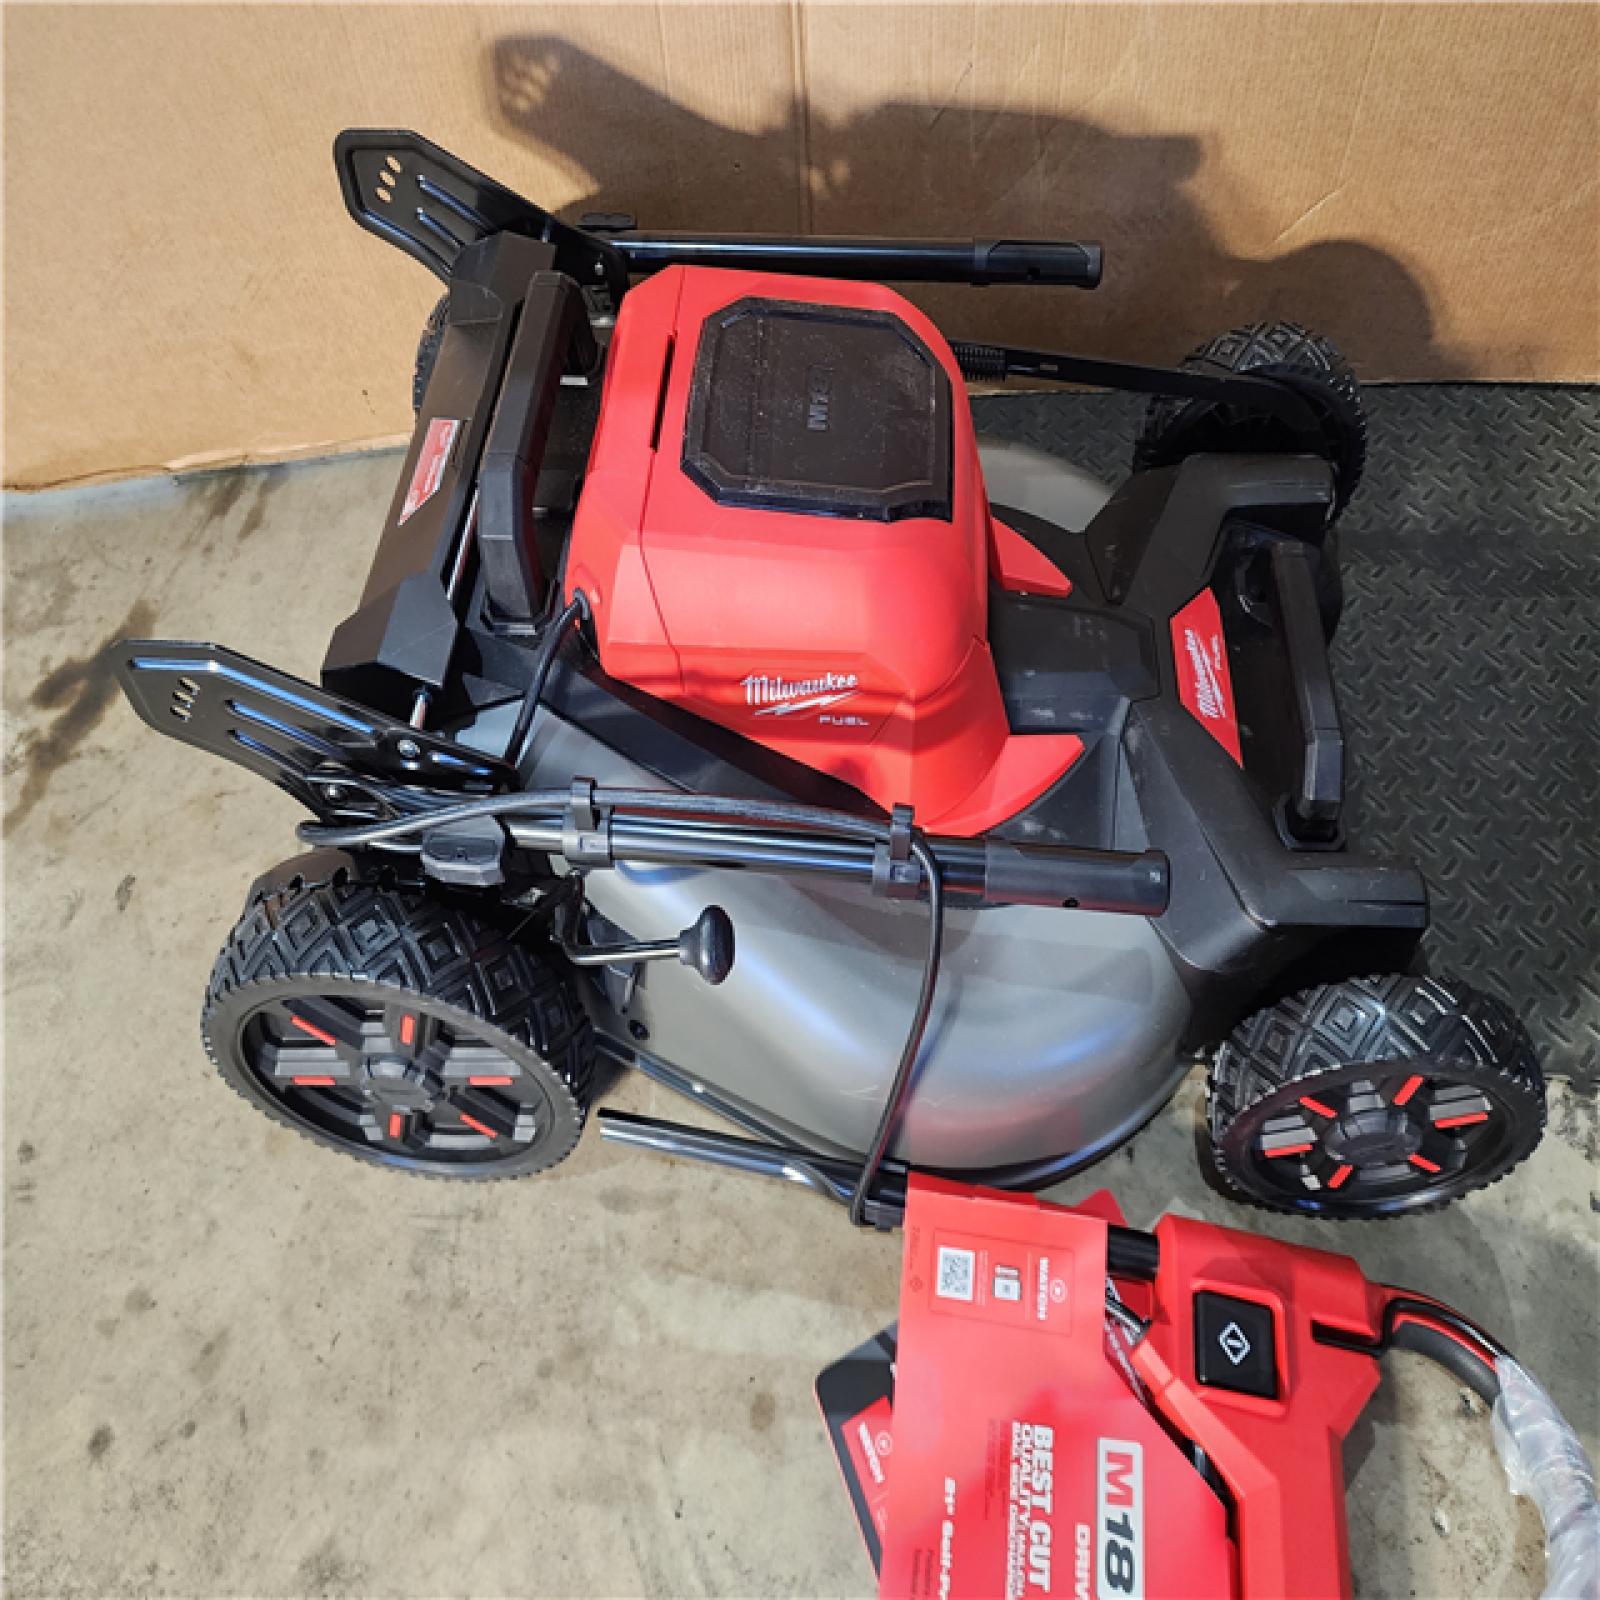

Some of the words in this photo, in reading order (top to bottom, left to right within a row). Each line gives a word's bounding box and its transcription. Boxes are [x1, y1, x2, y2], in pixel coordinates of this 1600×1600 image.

[740, 672, 858, 705] Milwaukee
[1185, 629, 1221, 718] Milwaukee
[818, 714, 868, 726] FUEL
[1031, 1424, 1053, 1515] BEST
[1029, 1519, 1051, 1593] CUT
[1104, 1450, 1135, 1595] M18
